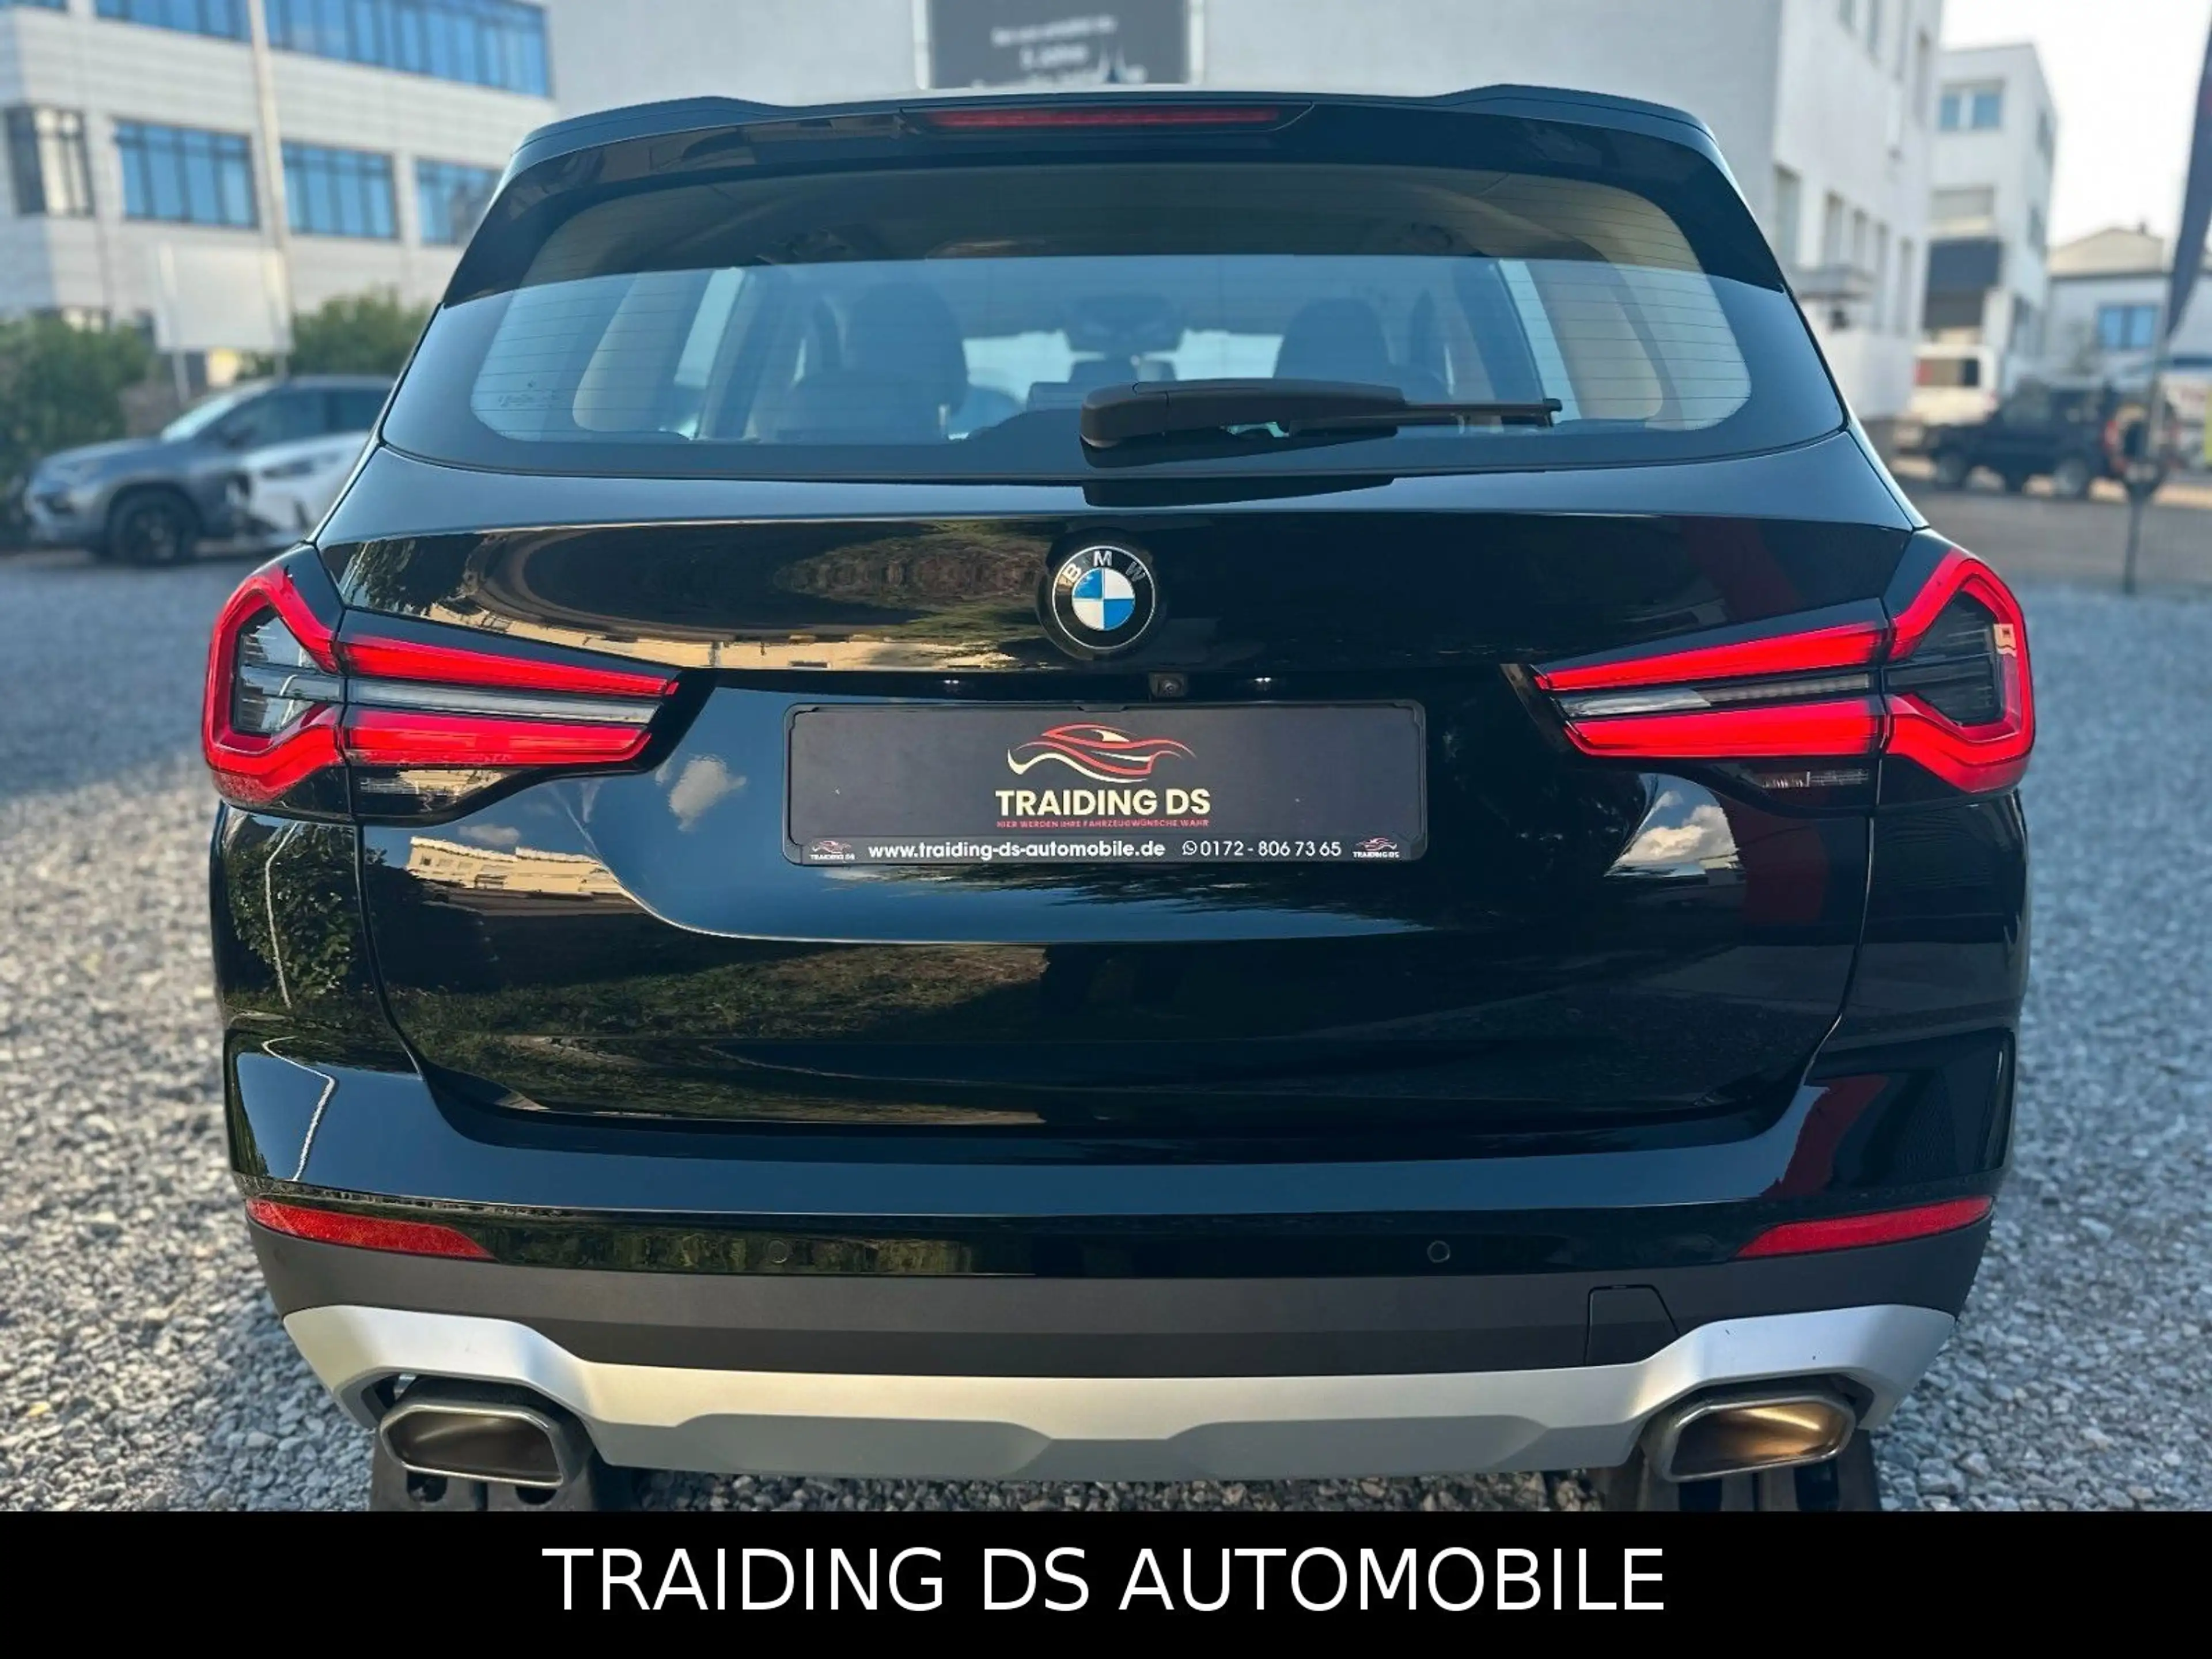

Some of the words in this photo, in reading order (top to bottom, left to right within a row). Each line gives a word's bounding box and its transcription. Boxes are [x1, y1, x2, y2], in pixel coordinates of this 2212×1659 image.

[1061, 550, 1146, 584] BMW
[995, 789, 1158, 816] TRAIDING
[1165, 788, 1211, 816] DS
[1180, 819, 1209, 827] WAHR
[868, 840, 1166, 860] www.traiding-ds-automobile.de
[1200, 840, 1244, 857] 0172
[1258, 840, 1290, 857] 806
[1295, 841, 1316, 857] 73
[1319, 841, 1342, 857] 65
